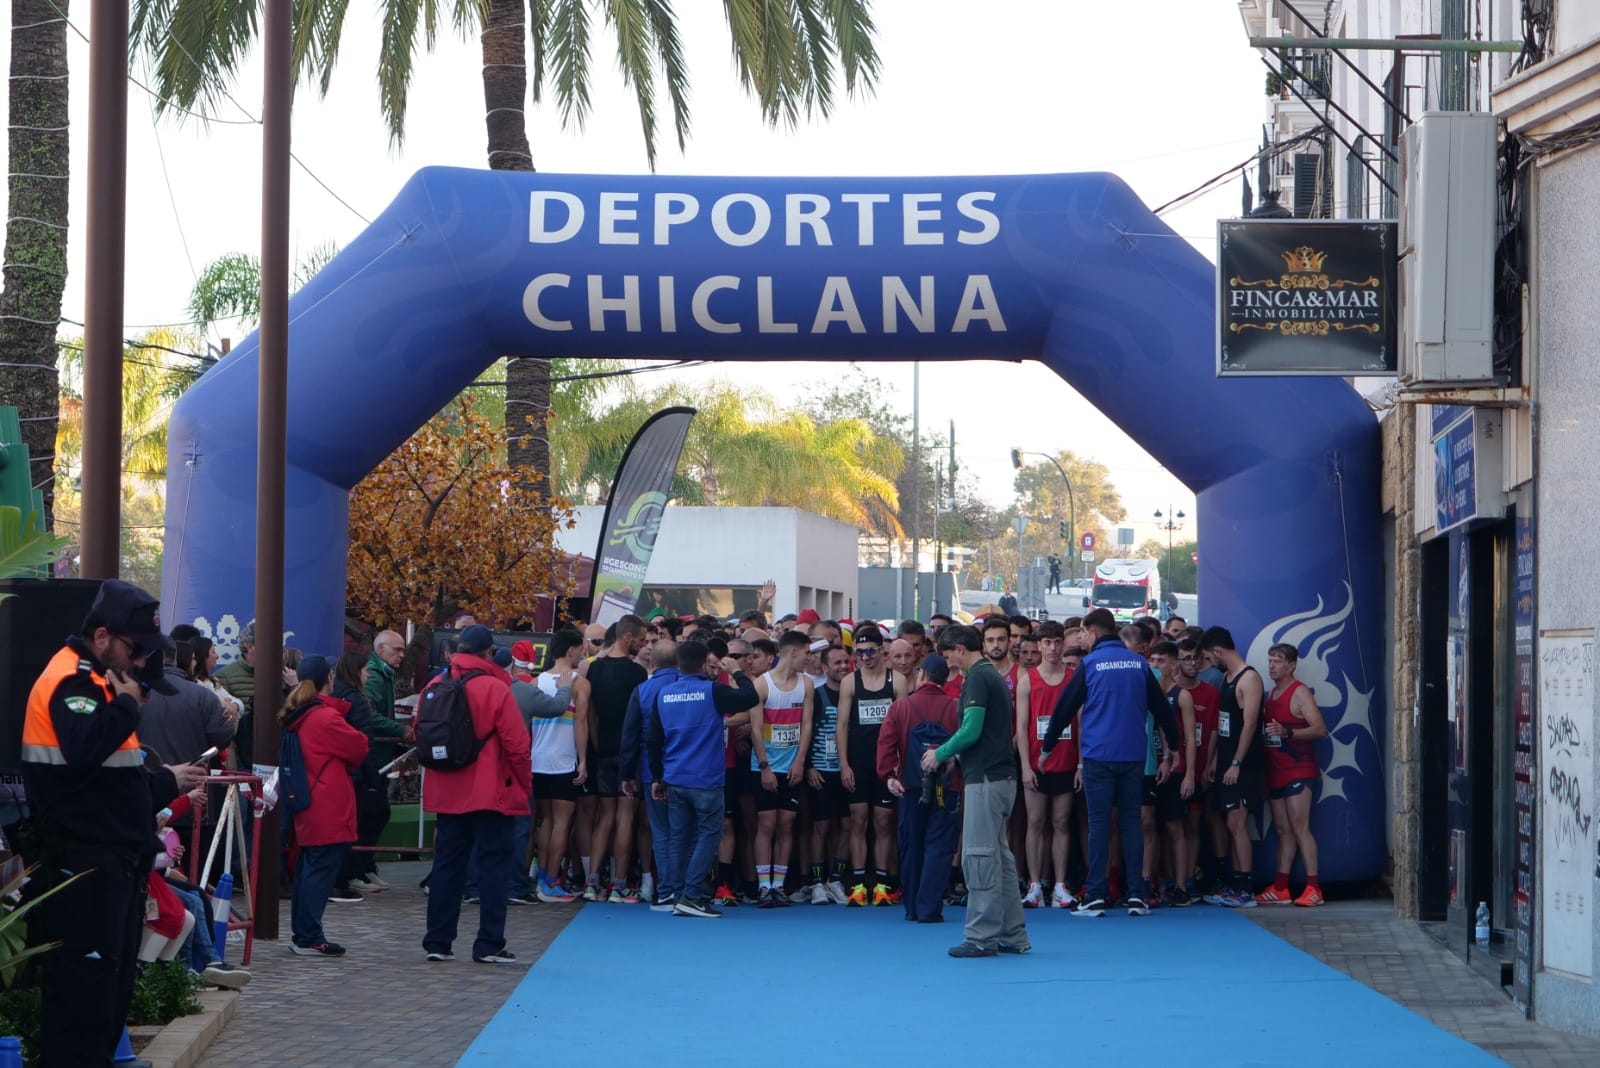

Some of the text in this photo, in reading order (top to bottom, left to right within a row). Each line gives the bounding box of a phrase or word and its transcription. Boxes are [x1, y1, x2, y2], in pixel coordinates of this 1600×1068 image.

[528, 190, 1001, 247] DEPORTES
[521, 272, 1008, 334] CHICLANA
[1230, 290, 1379, 308] FINCA&MAR
[1244, 309, 1366, 319] INMOBILIARIA
[1095, 660, 1142, 671] ORGANIZACIÓN
[865, 706, 887, 717] 1209
